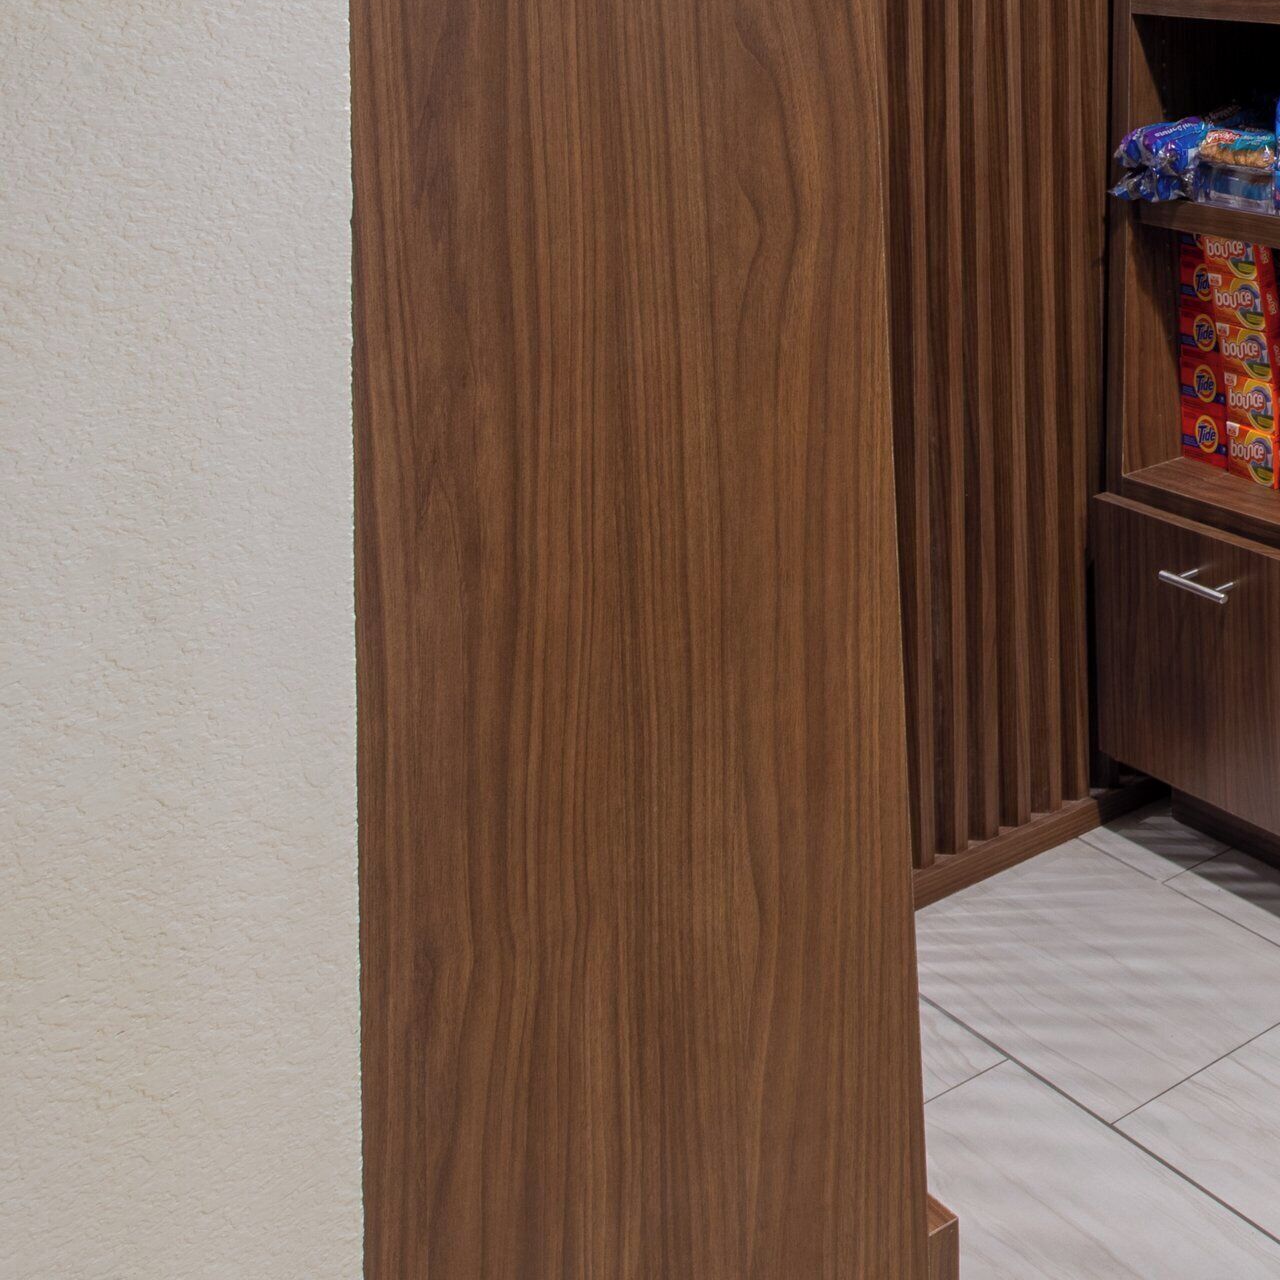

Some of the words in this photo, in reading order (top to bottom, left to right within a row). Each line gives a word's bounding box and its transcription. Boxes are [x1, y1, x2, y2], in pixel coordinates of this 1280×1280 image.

[1206, 239, 1244, 258] bounce
[1215, 288, 1251, 310] bounce
[1196, 326, 1214, 343] Tide
[1231, 441, 1265, 461] bounce
